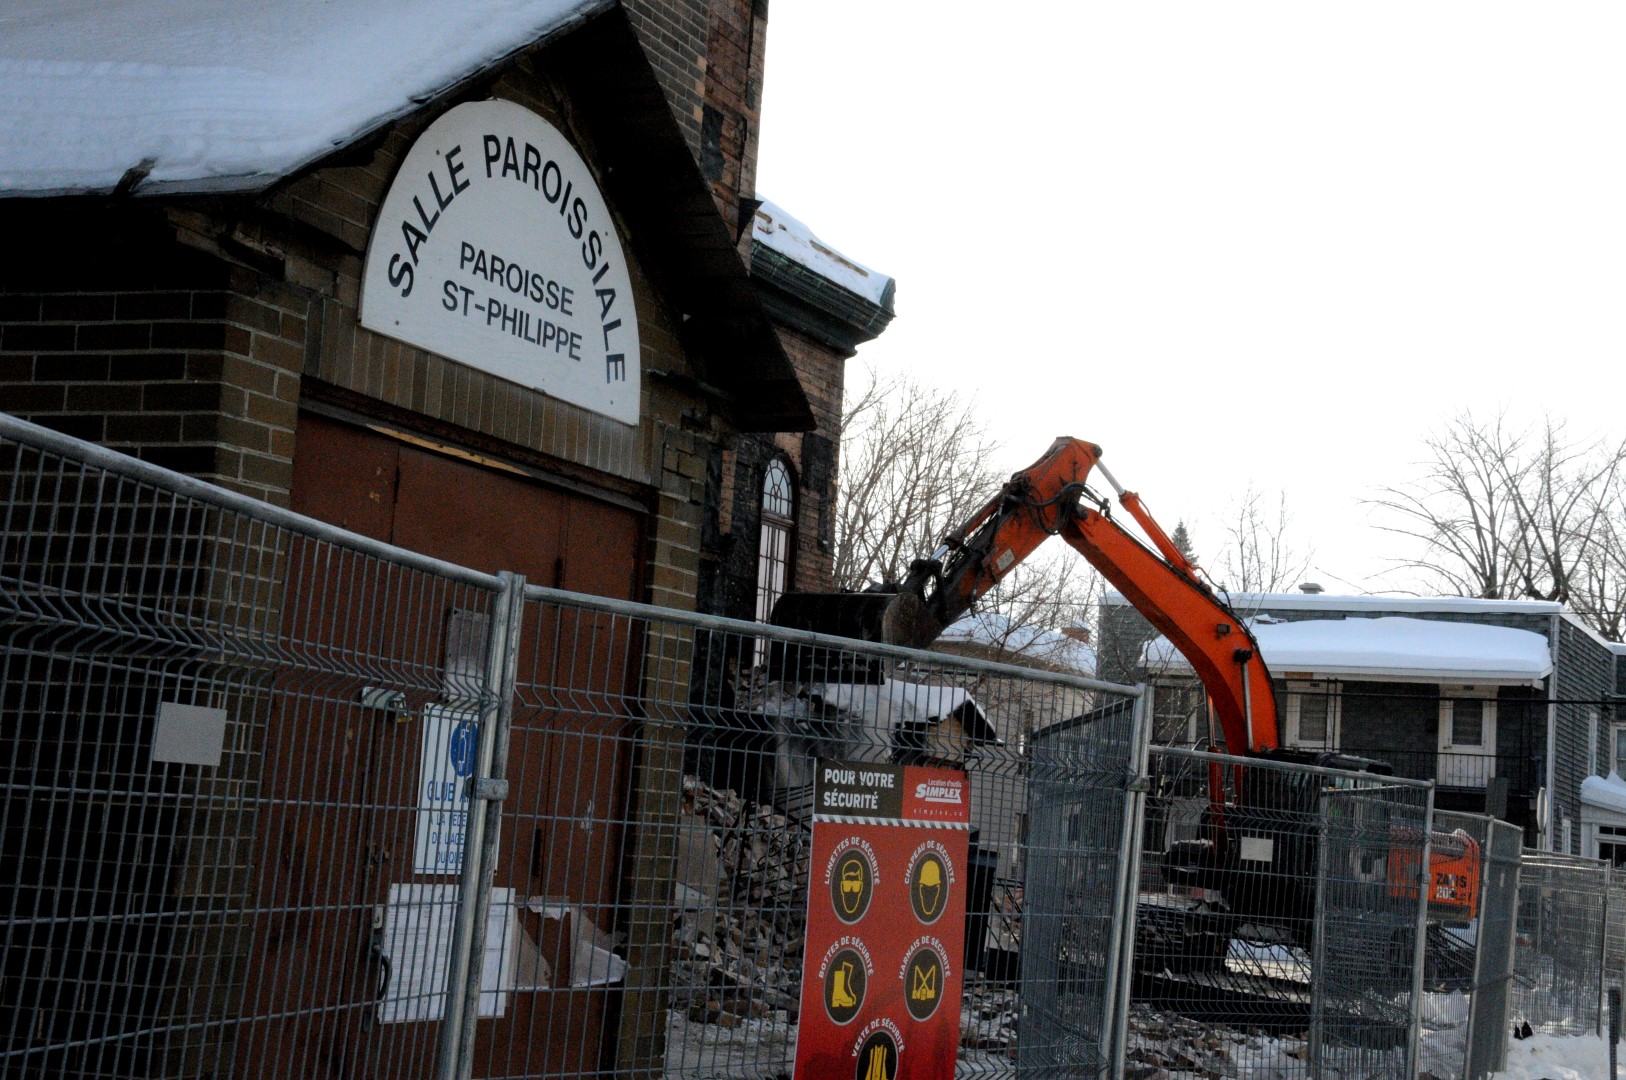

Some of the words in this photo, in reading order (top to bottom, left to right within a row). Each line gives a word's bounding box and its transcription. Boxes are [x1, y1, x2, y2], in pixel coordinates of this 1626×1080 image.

[388, 144, 471, 299] SALLE
[483, 134, 627, 385] PAROISSIALE
[460, 241, 575, 316] PAROISSE
[441, 280, 583, 361] ST-PHILIPPE
[427, 780, 455, 802] CLUB
[823, 788, 878, 810] SÉCURITÉ
[824, 768, 856, 785] POUR
[859, 771, 895, 788] VOTRE
[914, 783, 962, 800] SIMPLEX
[824, 838, 850, 885] LUNETTES
[851, 836, 861, 846] DE
[861, 839, 881, 885] SÉCURITÉ
[904, 843, 926, 884] CHAPEAU
[926, 840, 935, 849] DE
[936, 843, 956, 885] SÉCURITÉ
[818, 941, 840, 979] BOTTES
[840, 935, 850, 945] DE
[851, 937, 875, 977] SÉCURITÉ
[898, 938, 921, 980] HARNAIS
[921, 935, 930, 944] DE
[931, 937, 951, 977] SÉCURITÉ
[851, 1025, 870, 1057] VESTE
[870, 1018, 880, 1028] DE
[881, 1017, 906, 1053] SÉCURITÉ
